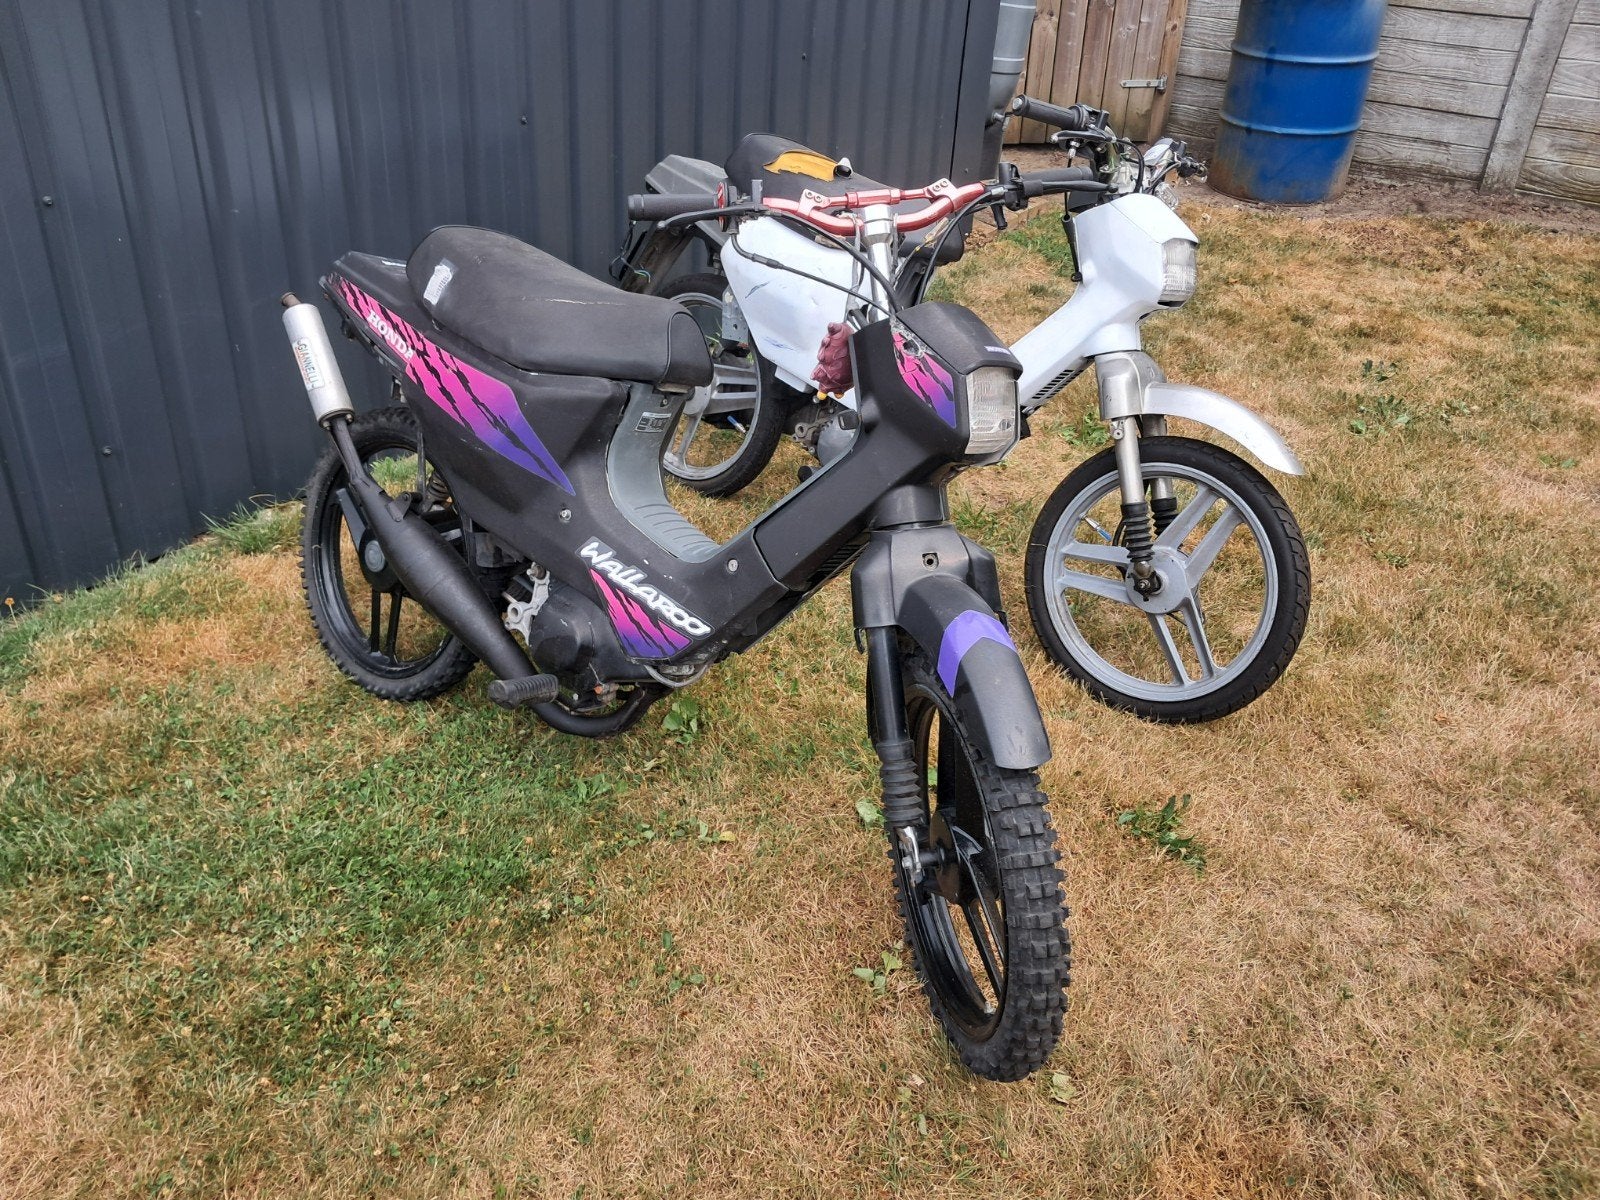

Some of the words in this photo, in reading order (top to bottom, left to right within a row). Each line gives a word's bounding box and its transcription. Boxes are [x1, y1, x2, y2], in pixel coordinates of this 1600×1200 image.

[367, 309, 414, 361] HONDA
[297, 342, 320, 384] GIANNELLI
[580, 541, 711, 636] WALLAROO
